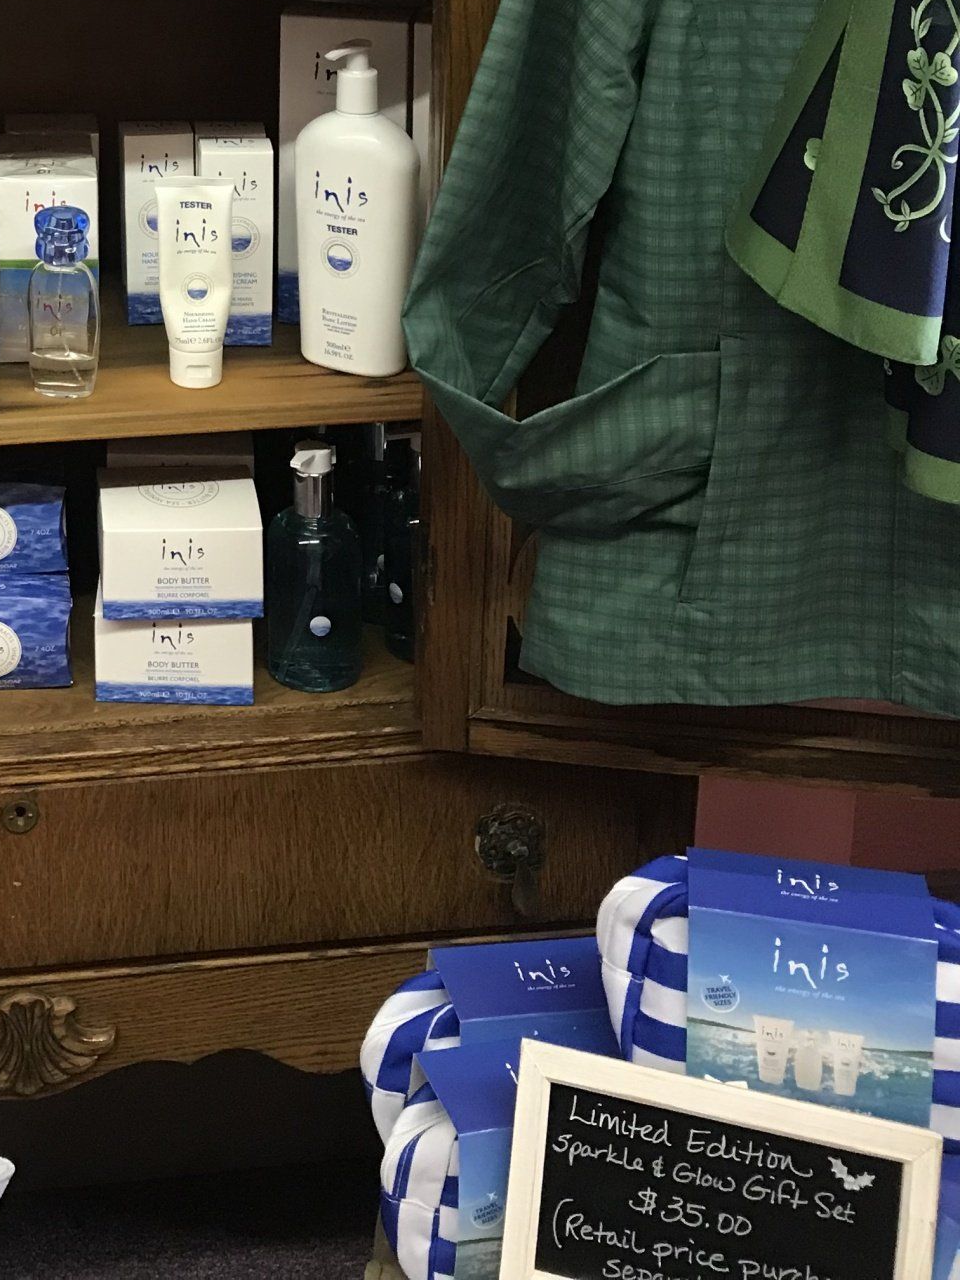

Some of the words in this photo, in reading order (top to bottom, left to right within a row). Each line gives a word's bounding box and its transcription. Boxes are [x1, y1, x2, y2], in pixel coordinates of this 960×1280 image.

[140, 153, 180, 178] inis
[179, 201, 212, 210] TESTER
[314, 170, 369, 214] inis
[176, 218, 219, 248] inis
[326, 224, 358, 236] TESTER
[162, 538, 205, 566] inis
[152, 622, 195, 650] inis
[776, 869, 839, 894] inis
[514, 958, 571, 985] inis
[772, 936, 850, 990] inis
[704, 992, 736, 1000] FRIENDLY
[706, 986, 732, 994] TRAVEL
[787, 988, 810, 998] energy
[812, 991, 820, 1000] of
[569, 1094, 672, 1147] Limited
[686, 1128, 815, 1178] Edition
[551, 1133, 645, 1172] Sparkle
[672, 1162, 736, 1193] Glow
[742, 1174, 809, 1210] Gift
[814, 1192, 857, 1224] Set
[552, 1198, 646, 1255] (Retail
[652, 1234, 731, 1274] price
[738, 1258, 834, 1280] purch
